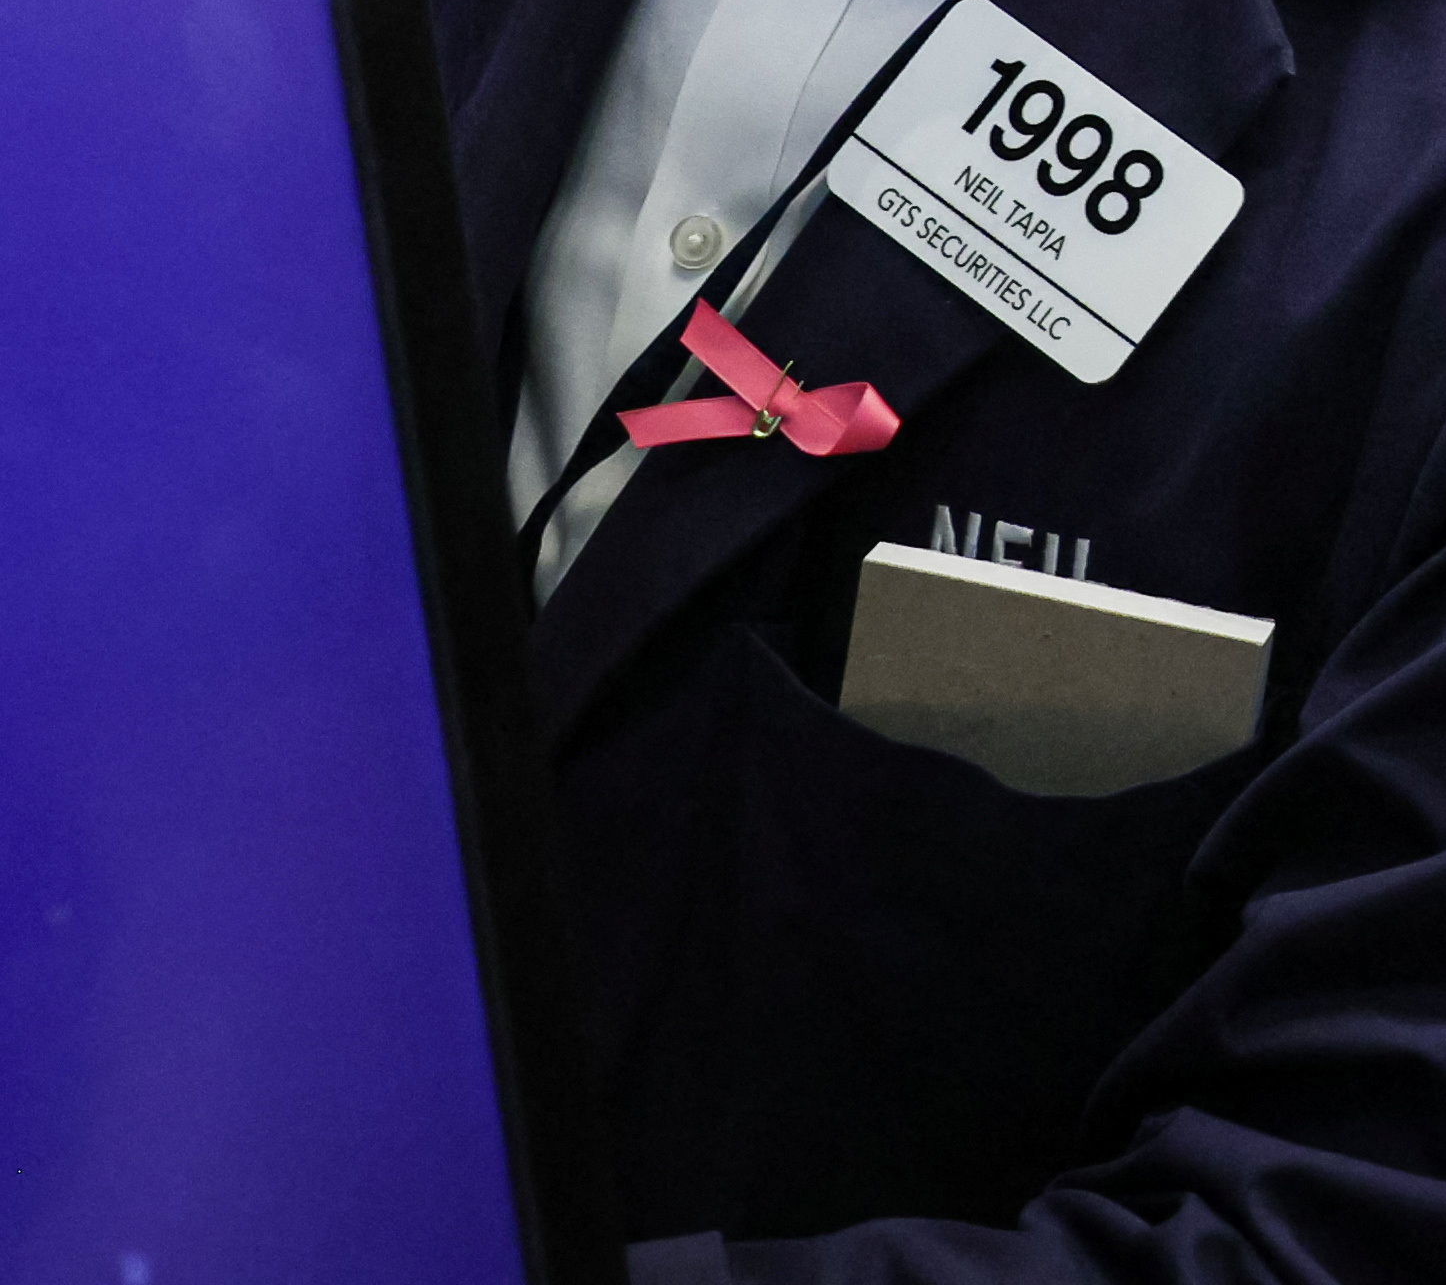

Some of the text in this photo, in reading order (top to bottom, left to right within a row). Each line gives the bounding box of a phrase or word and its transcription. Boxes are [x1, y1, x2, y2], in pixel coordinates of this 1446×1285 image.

[954, 166, 1066, 260] NEIL TAPIA
[961, 59, 1164, 235] 1998
[878, 188, 1071, 340] GTS SECURITIES LLC
